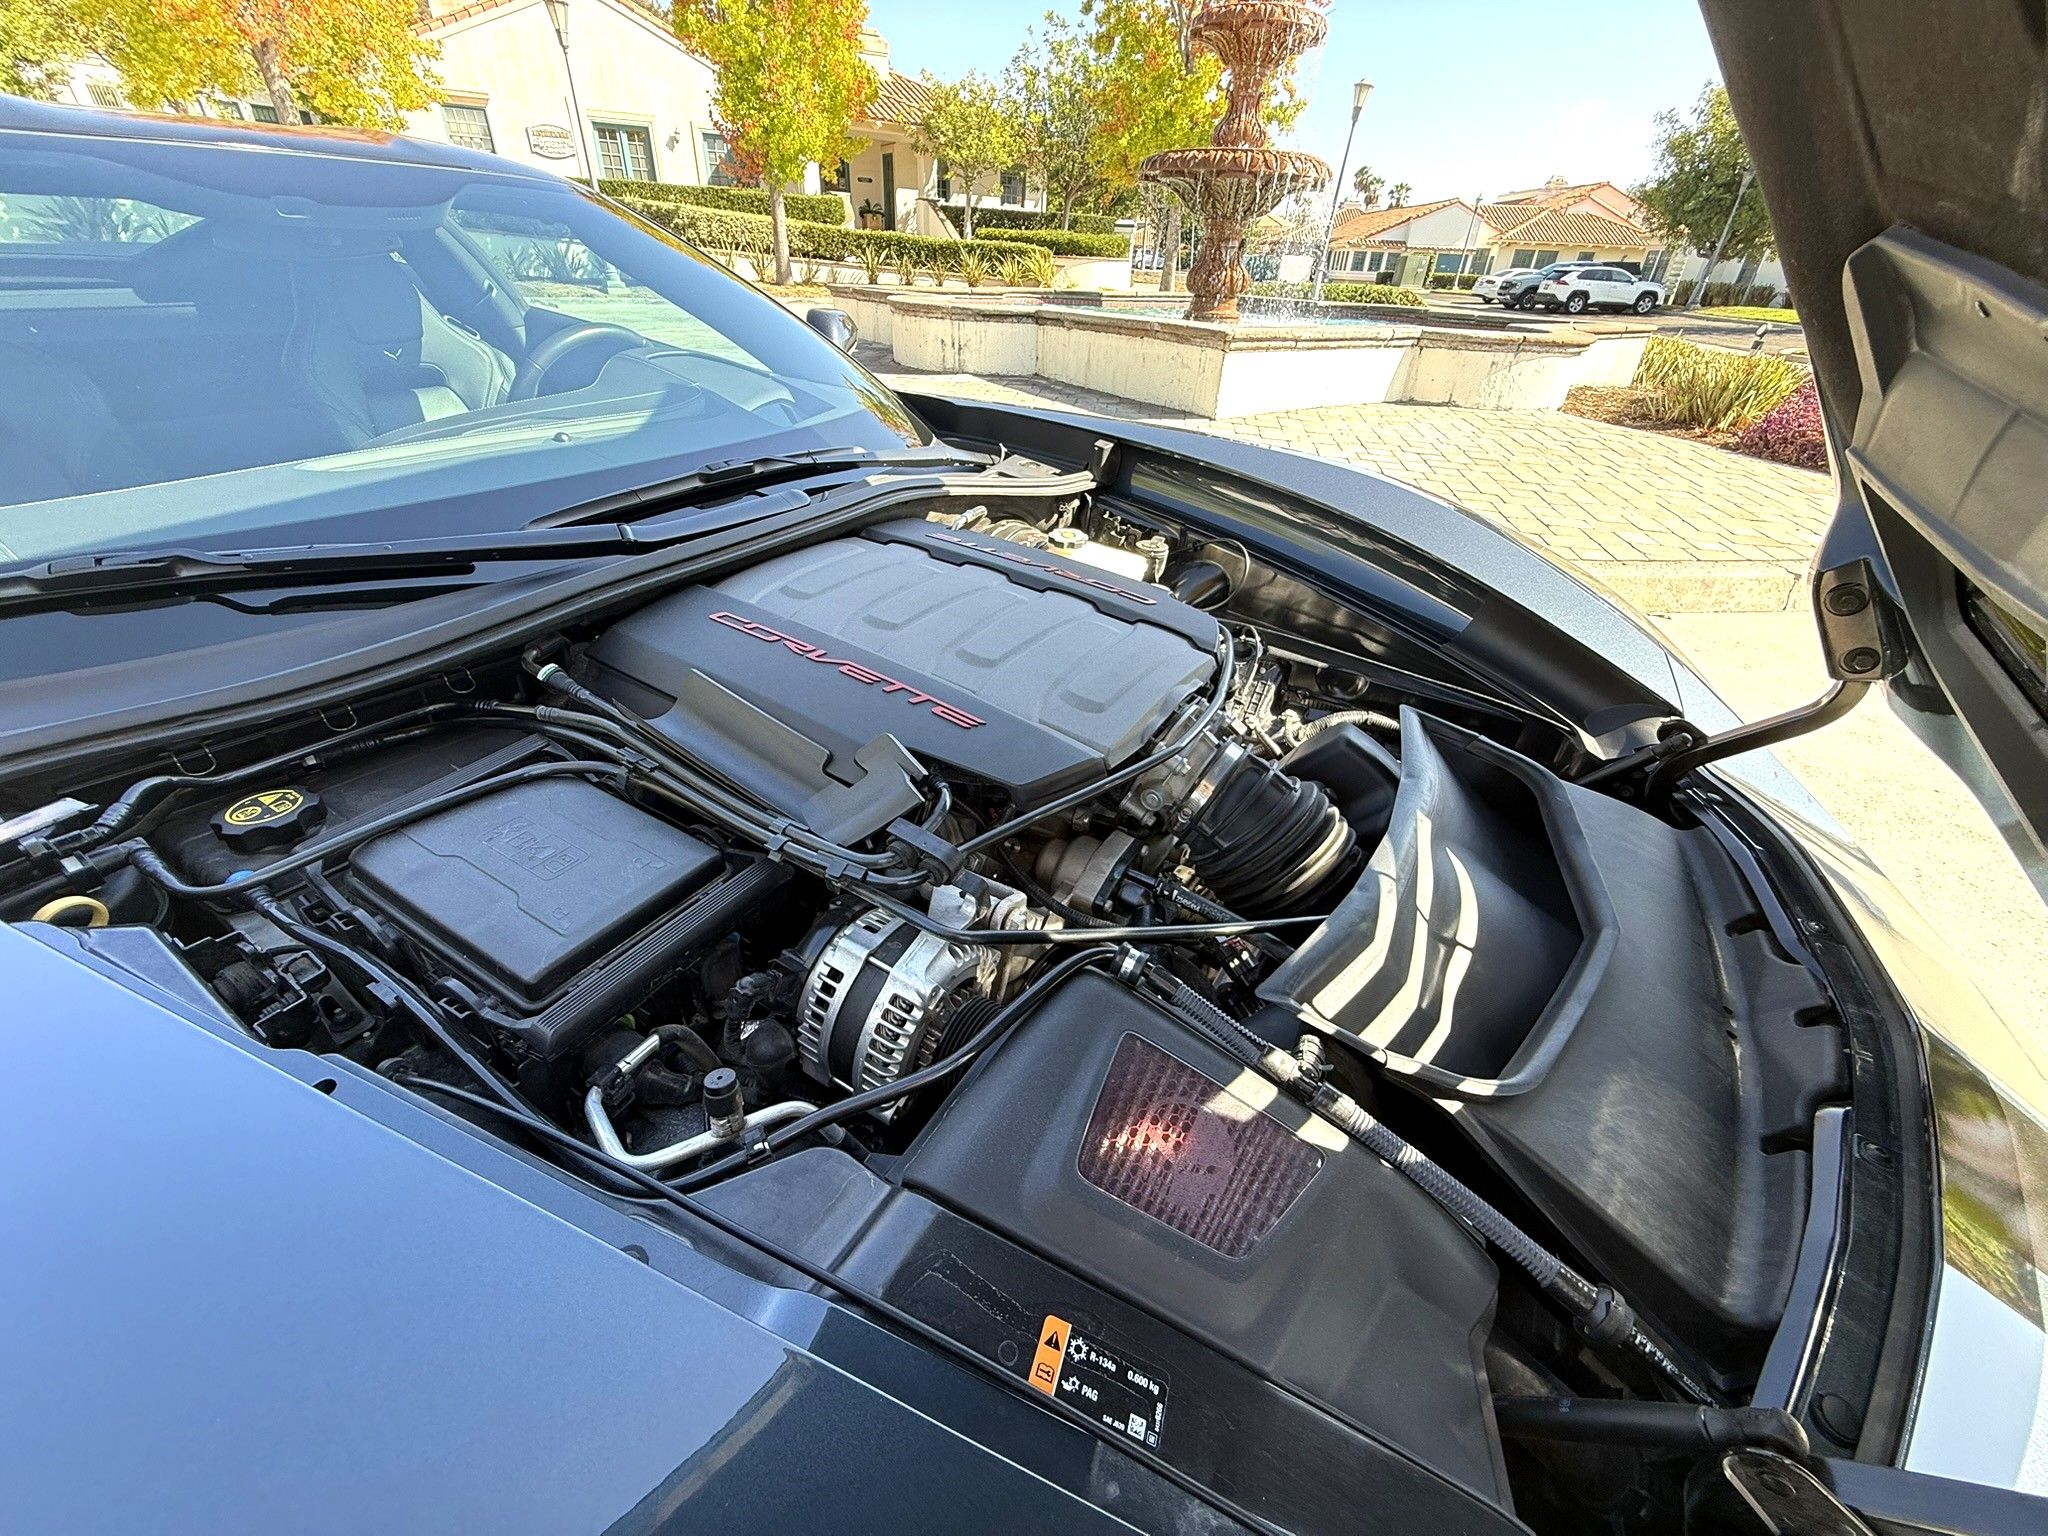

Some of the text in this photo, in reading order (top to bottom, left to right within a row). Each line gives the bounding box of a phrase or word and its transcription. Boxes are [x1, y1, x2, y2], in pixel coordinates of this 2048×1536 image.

[708, 611, 987, 730] CORVETTE
[1081, 1384, 1098, 1402] PAG
[1089, 1351, 1160, 1396] R-134a 0.600 kg
